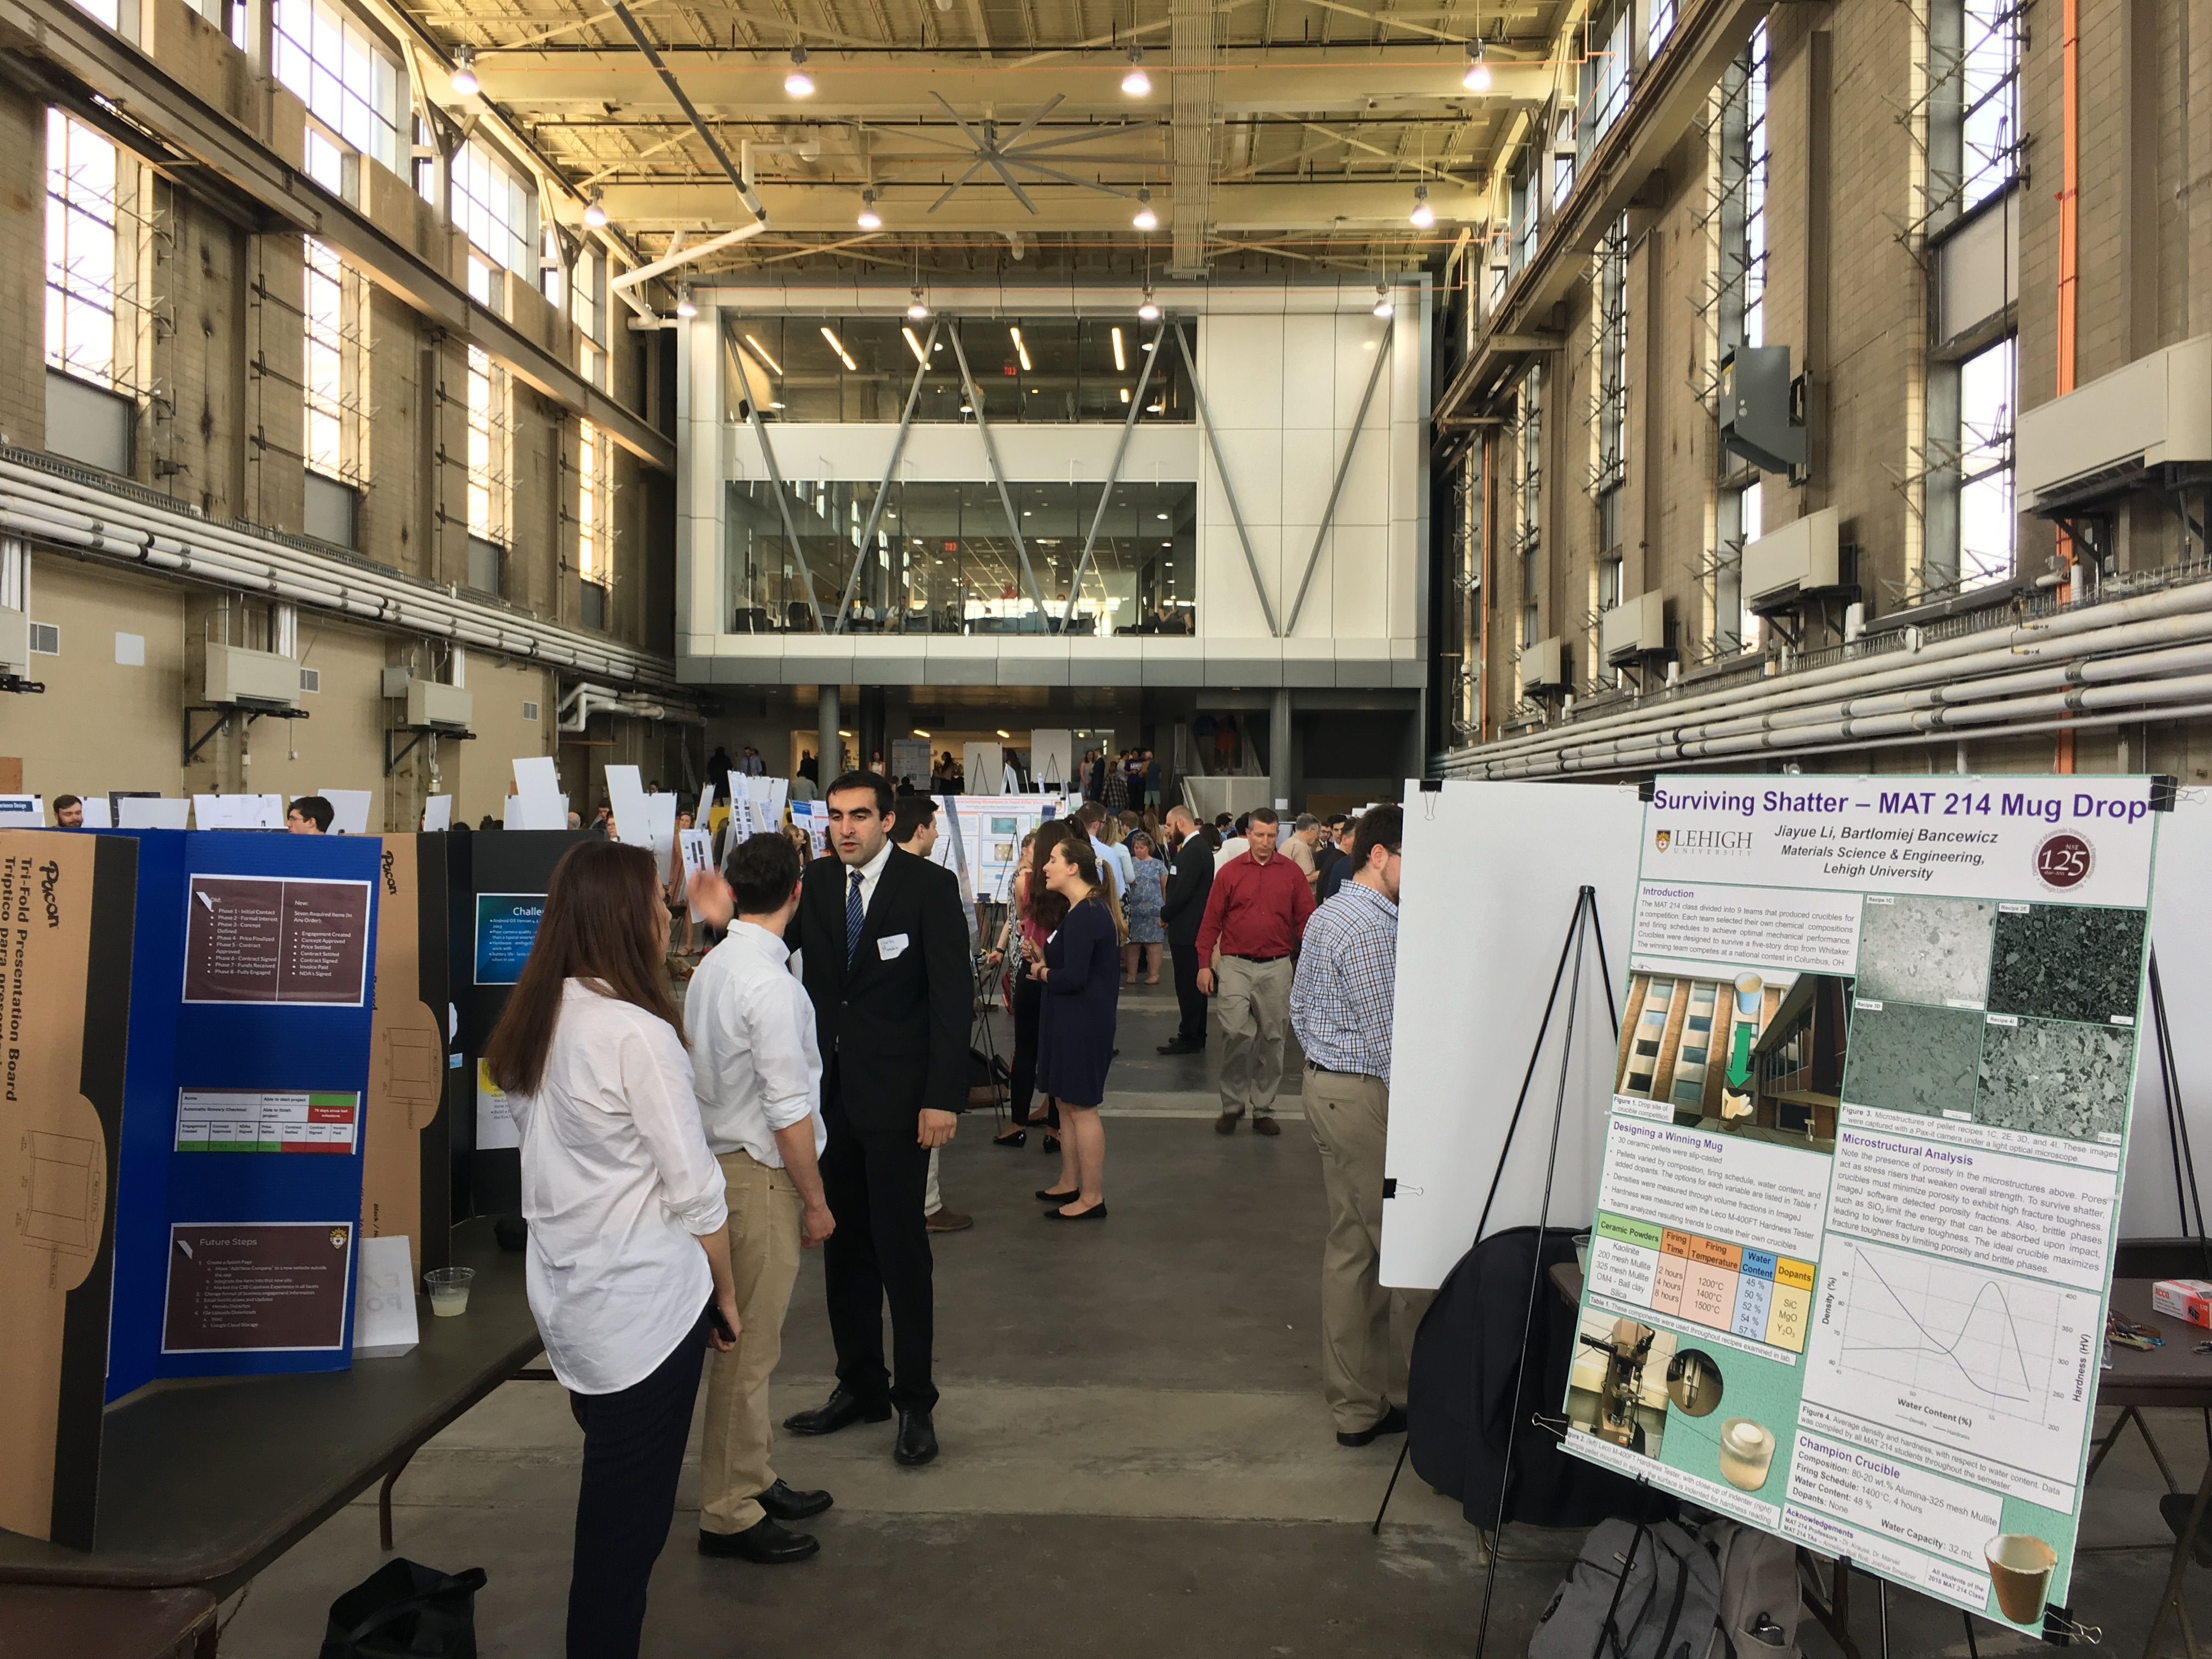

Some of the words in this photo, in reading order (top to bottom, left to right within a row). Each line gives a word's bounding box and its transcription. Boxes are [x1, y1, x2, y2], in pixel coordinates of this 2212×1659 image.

[1654, 790, 1755, 817] Surviving
[1763, 791, 1849, 812] Shatter
[1879, 792, 1936, 814] MAT
[1943, 793, 1991, 815] 214
[2001, 793, 2061, 823] Mug
[2073, 794, 2146, 824] Drop
[1675, 830, 1752, 849] LEHIGH
[1774, 825, 1816, 840] Jiayue
[1820, 826, 1835, 840] Li,
[1841, 827, 1914, 844] Bartlomiej
[1917, 828, 1998, 843] Bancewicz
[1674, 848, 1752, 856] UNIVERSITY
[1781, 845, 1833, 857] Materials
[1837, 847, 1886, 859] Science
[1890, 849, 1898, 860] &
[1903, 849, 1984, 866] Engineering,
[2040, 849, 2087, 876] 125
[381, 850, 397, 895] Pacon
[1824, 862, 1865, 877] Lehigh
[1870, 865, 1933, 881] University
[18, 857, 32, 923] Tri-Fold
[39, 860, 59, 928] Pacon
[1643, 887, 1694, 898] Introduction
[1700, 904, 1722, 912] divided
[1779, 910, 1810, 918] produced
[1812, 913, 1842, 921] crucibles
[9, 929, 27, 1042] Presentation
[6, 1048, 20, 1102] Board
[1613, 1121, 1655, 1139] Designing
[1666, 1131, 1701, 1148] Winning
[1703, 1139, 1723, 1153] Mug
[1842, 1133, 1922, 1156] Microstructural
[1925, 1148, 1973, 1165] Analysis
[1841, 1148, 1858, 1158] Note
[1861, 1152, 1872, 1160] the
[1875, 1156, 1910, 1167] presence
[1922, 1165, 1954, 1177] porosity
[1956, 1170, 1963, 1178] in
[1967, 1171, 1979, 1181] the
[1983, 1176, 2045, 1193] microstructures
[2049, 1187, 2076, 1199] above.
[2081, 1193, 2107, 1205] Pores
[232, 1238, 257, 1246] Steps
[1601, 1221, 1628, 1234] Ceramic
[1629, 1228, 1658, 1242] Powders
[1666, 1231, 1686, 1245] Firing
[1612, 1242, 1640, 1256] Kaolinite
[1667, 1243, 1683, 1255] Time
[1706, 1241, 1727, 1255] Firing
[1748, 1251, 1771, 1265] Water
[1598, 1250, 1610, 1259] 200
[1611, 1255, 1629, 1265] mesh
[1630, 1258, 1651, 1271] Mullite
[1691, 1250, 1738, 1269] Temperature
[1596, 1261, 1608, 1270] 325
[1609, 1266, 1627, 1276] mesh
[1628, 1269, 1649, 1282] Mullite
[1658, 1266, 1663, 1274] 2
[1664, 1268, 1683, 1279] hours
[1742, 1263, 1773, 1279] Content
[1778, 1266, 1811, 1282] Dopants
[1596, 1272, 1612, 1283] OM4
[1618, 1278, 1630, 1288] Ball
[1632, 1283, 1645, 1294] clay
[1610, 1288, 1627, 1299] Silica
[1662, 1279, 1681, 1291] hours
[1827, 1277, 1837, 1290] (%)
[2154, 1287, 2170, 1300] ACCO
[1654, 1289, 1659, 1297] 8
[1661, 1290, 1679, 1302] hours
[1783, 1299, 1797, 1309] SiC
[1779, 1310, 1797, 1322] MgO
[1822, 1293, 1835, 1325] Density
[2079, 1334, 2091, 1355] (HV)
[2073, 1358, 2086, 1402] Hardness
[1898, 1397, 1922, 1411] Water
[1924, 1406, 1956, 1422] Content
[1958, 1416, 1972, 1427] (%)
[1799, 1436, 1852, 1462] Champion
[1855, 1455, 1900, 1479] Crucible
[1795, 1474, 1816, 1488] Water
[1818, 1483, 1851, 1501] Content:
[1853, 1497, 1863, 1505] 48
[1865, 1500, 1872, 1509] %
[1796, 1462, 1818, 1479] Firing
[1820, 1471, 1859, 1491] Schedule:
[1900, 1499, 1922, 1514] hours
[1798, 1451, 1849, 1475] Composition:
[1852, 1469, 1874, 1483] 80-20
[1875, 1479, 1893, 1490] wt.%
[1895, 1484, 1944, 1508] Alumina-325
[1946, 1503, 1968, 1516] mesh
[1971, 1510, 1997, 1526] Mullite
[1792, 1486, 1826, 1506] Dopants:
[1829, 1500, 1848, 1514] None
[1786, 1508, 1853, 1538] Acknowledgements
[1881, 1519, 1905, 1533] Water
[1906, 1528, 1946, 1550] Capacity:
[1948, 1543, 1959, 1554] 32
[1961, 1550, 1973, 1560] mL
